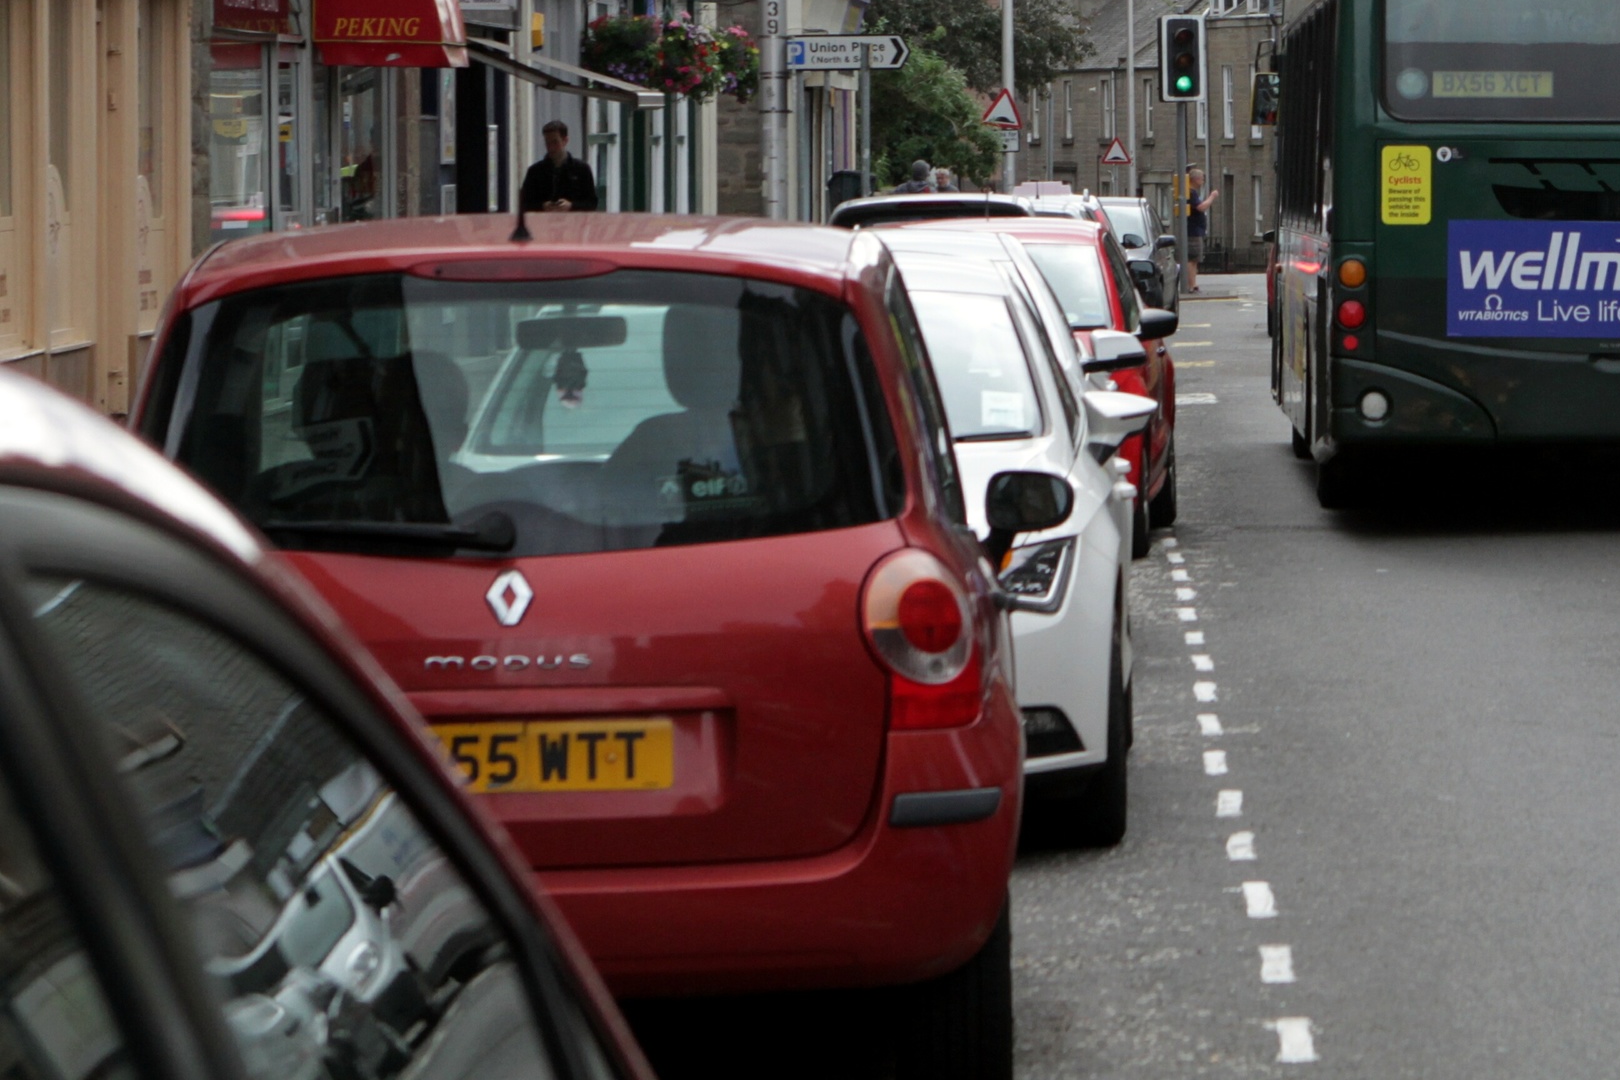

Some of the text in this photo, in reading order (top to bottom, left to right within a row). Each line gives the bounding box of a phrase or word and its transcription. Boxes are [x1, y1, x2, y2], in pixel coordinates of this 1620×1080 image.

[333, 17, 420, 37] PEKING
[810, 42, 846, 52] Union
[852, 42, 886, 52] Plce
[811, 56, 842, 64] (North
[844, 56, 850, 64] &
[1442, 73, 1543, 93] BX56 XCT
[1388, 176, 1422, 186] Cyclists
[1458, 310, 1529, 322] VITABIOTICS
[1536, 300, 1591, 323] Live
[450, 730, 646, 785] 55 WTT
